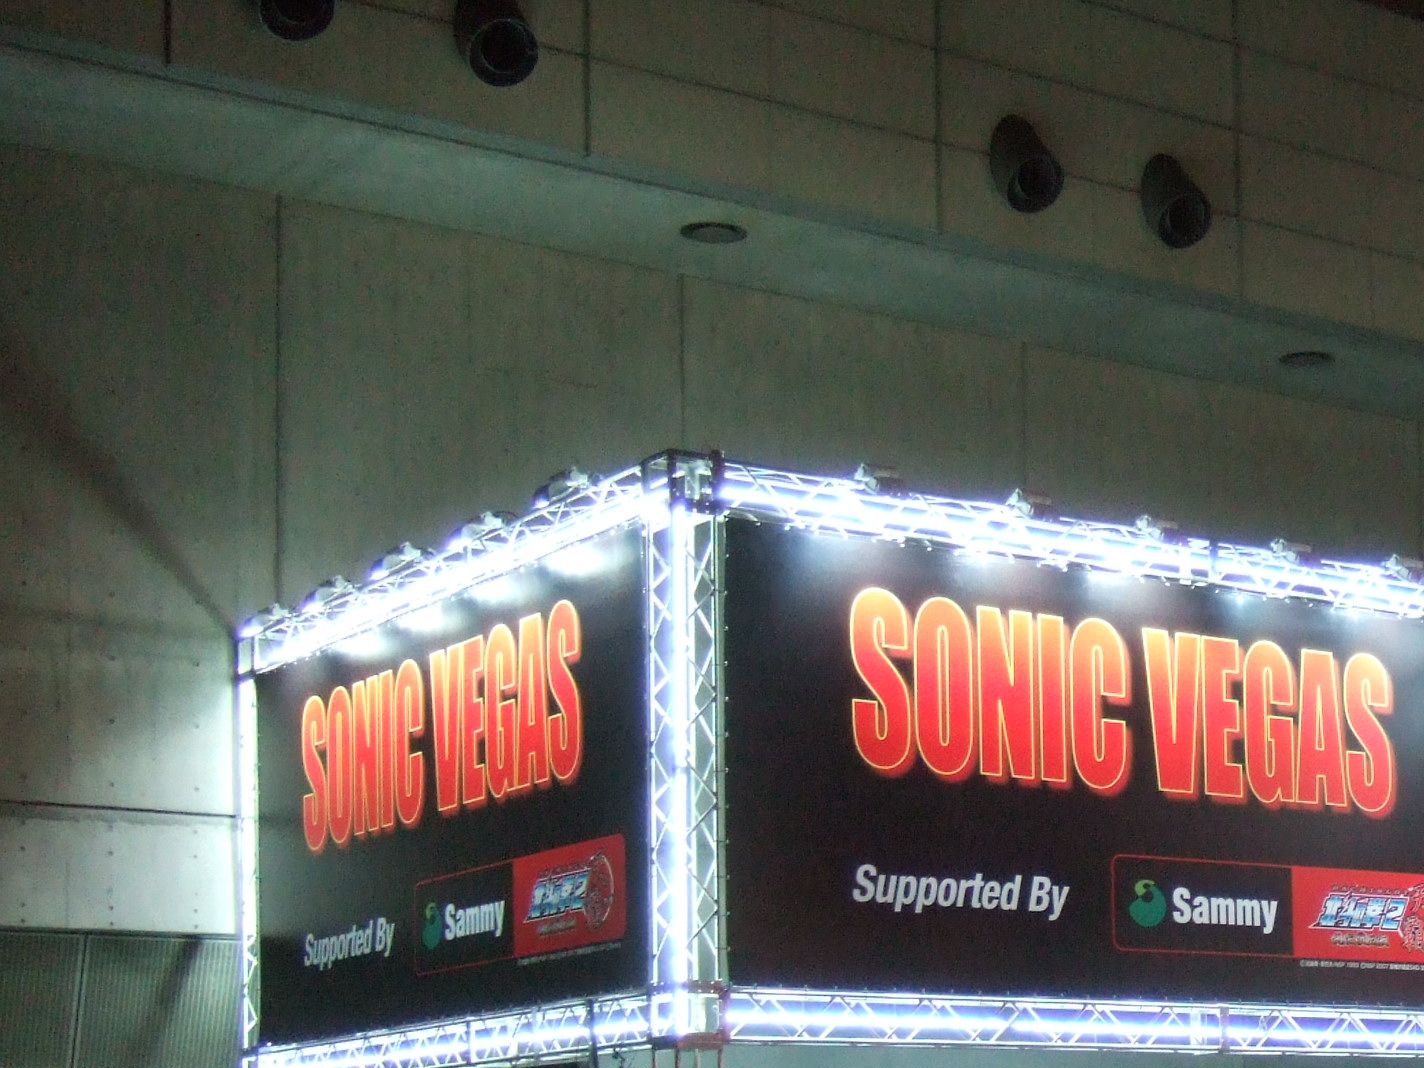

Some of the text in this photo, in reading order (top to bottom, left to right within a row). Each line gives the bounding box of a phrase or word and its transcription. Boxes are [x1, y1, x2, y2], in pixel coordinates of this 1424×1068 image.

[302, 599, 580, 851] SONIC VEGAS
[849, 587, 1395, 812] SONIC VEGAS
[852, 863, 1070, 921] Supported By
[1172, 886, 1279, 935] Sammy
[303, 917, 396, 971] Supported By
[444, 900, 506, 941] Sammy
